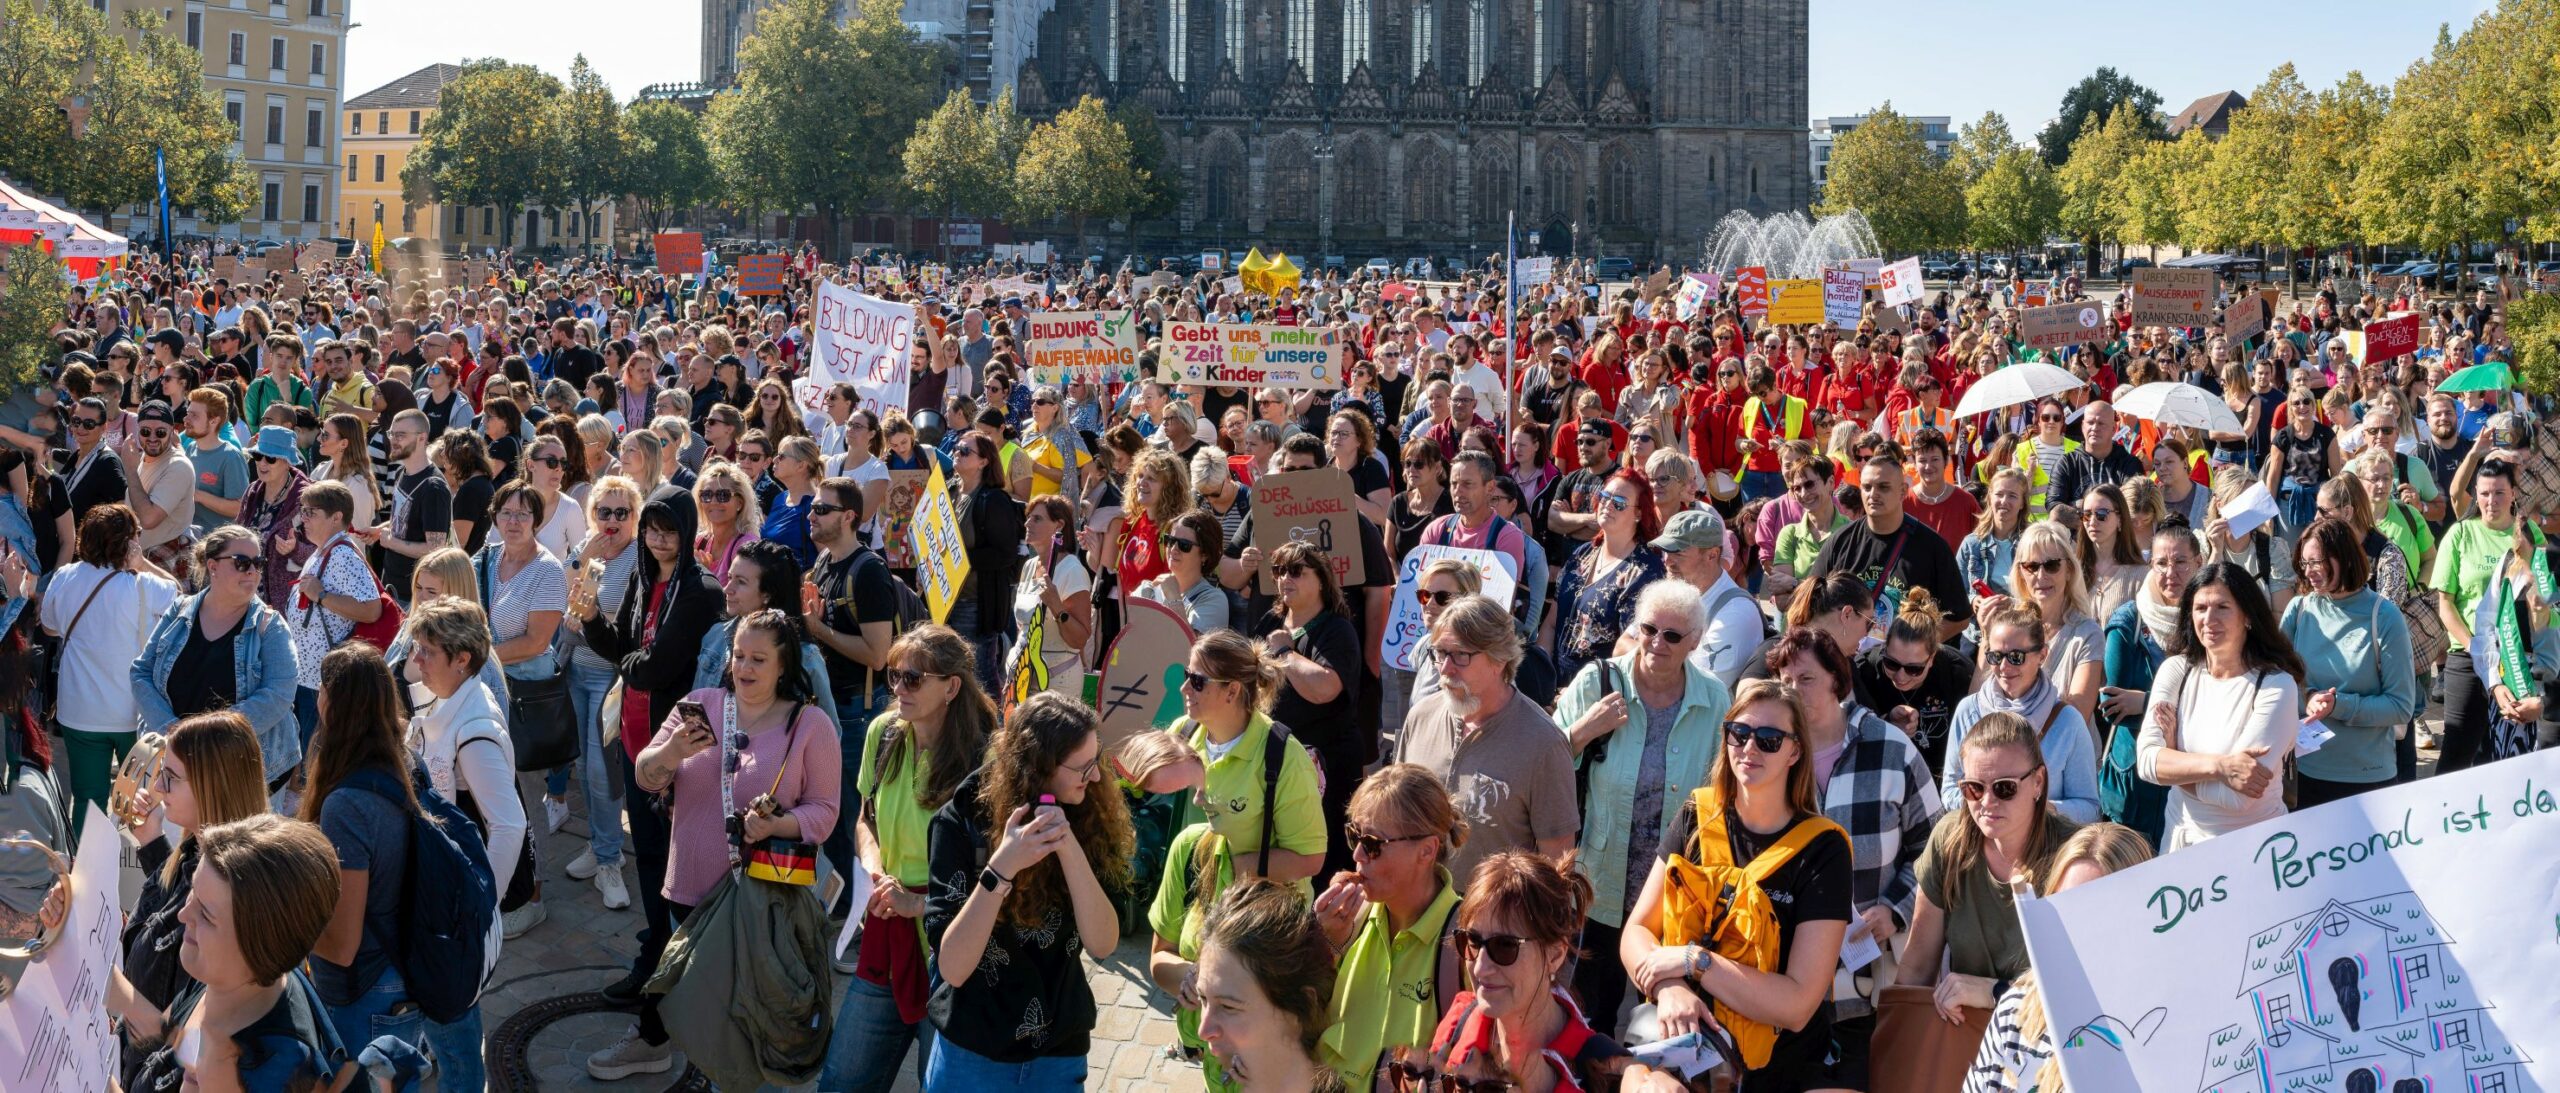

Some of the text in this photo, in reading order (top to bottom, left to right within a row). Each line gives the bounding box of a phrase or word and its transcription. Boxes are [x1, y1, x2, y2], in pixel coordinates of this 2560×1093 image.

[1826, 270, 1862, 291] Bildung
[1835, 285, 1855, 294] statt
[1827, 289, 1859, 302] horten!
[2143, 288, 2206, 299] AUSGEBRANNT
[2136, 311, 2210, 326] KRANKENSTAND
[1032, 320, 1098, 340] BILDUNG
[1171, 325, 1318, 345] Gebt uns mehr
[1184, 345, 1327, 363] Zeit für unsere
[868, 355, 907, 385] KEIN
[1206, 364, 1267, 382] Kinder
[1260, 486, 1294, 504] DER
[1273, 496, 1348, 517] SCHLÜSSEL
[938, 491, 962, 565] QUALITÄT
[924, 522, 951, 598] BRAUCHT
[2146, 874, 2228, 933] Das
[2253, 807, 2424, 891] Personal
[2443, 794, 2492, 834] ist
